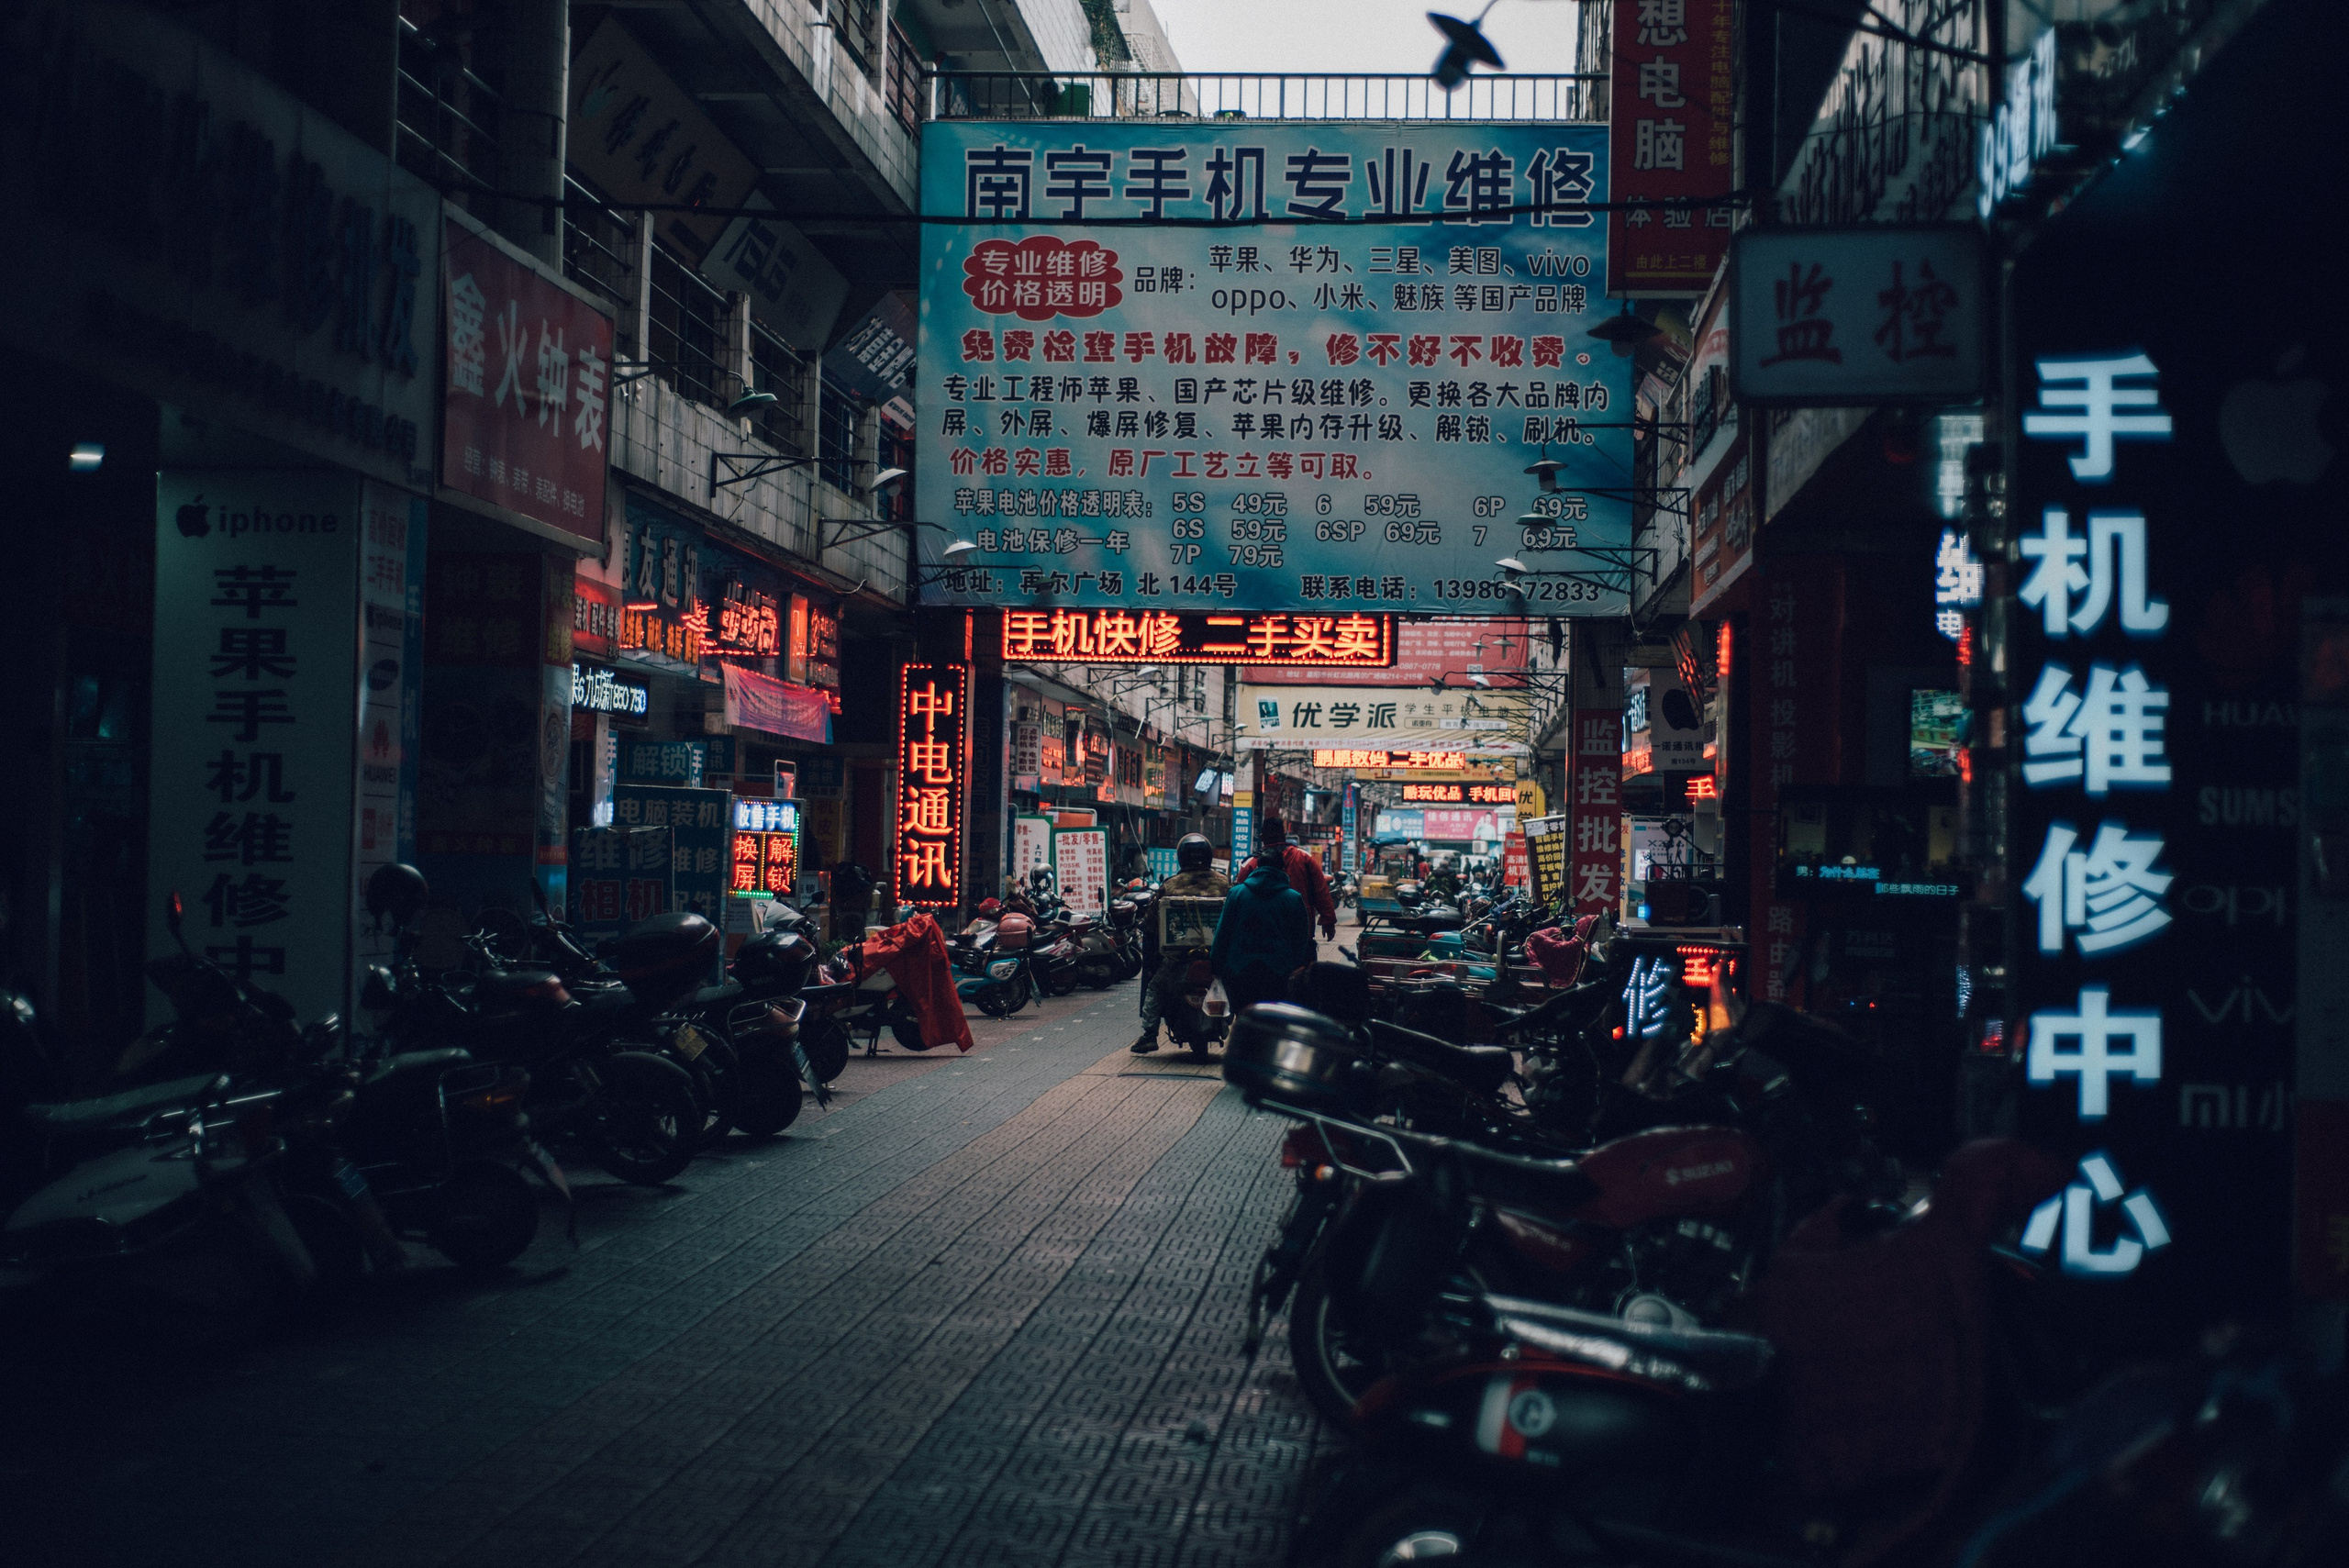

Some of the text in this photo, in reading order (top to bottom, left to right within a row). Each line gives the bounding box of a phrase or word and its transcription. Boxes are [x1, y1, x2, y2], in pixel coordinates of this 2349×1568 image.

[965, 143, 1595, 227] 南宇手机专业维修
[980, 249, 1108, 277] 专业维修
[1209, 245, 1590, 277] 苹果、华为、三星、美图、vivo
[980, 279, 1108, 308] 价格透明
[1453, 284, 1586, 314] 等国产品牌
[1758, 260, 1959, 367] 监控
[451, 272, 607, 455] 鑫火钟表
[954, 488, 1152, 517] 苹果电池价格透明表：
[1173, 492, 1206, 514] 5S
[1231, 493, 1287, 517] 49元
[1316, 494, 1331, 515] 6
[1364, 494, 1420, 518] 59元
[1473, 495, 1506, 517] 6P
[219, 506, 339, 539] iphone
[976, 518, 1577, 554] 电池保修一年 6S 59元 6SP 69元 7 69元
[1170, 543, 1284, 568] 7P 79元
[1138, 572, 1160, 595] 北
[1169, 573, 1238, 598] 144号
[1009, 610, 1182, 655] 手机快修
[1202, 613, 1377, 659] 二手买卖
[1292, 702, 1397, 728] 优学派
[201, 563, 298, 975] 苹果手机维修中
[631, 742, 688, 778] 解锁
[903, 680, 954, 888] 中电通讯
[1403, 784, 1518, 804] 酷玩优品 手机回
[618, 796, 721, 828] 电脑装机
[1577, 717, 1618, 904] 监控批发
[2020, 352, 2175, 1273] 手机维修中心
[579, 829, 669, 871] 维修
[1537, 854, 1564, 863] 高价回
[579, 876, 670, 921] 相机
